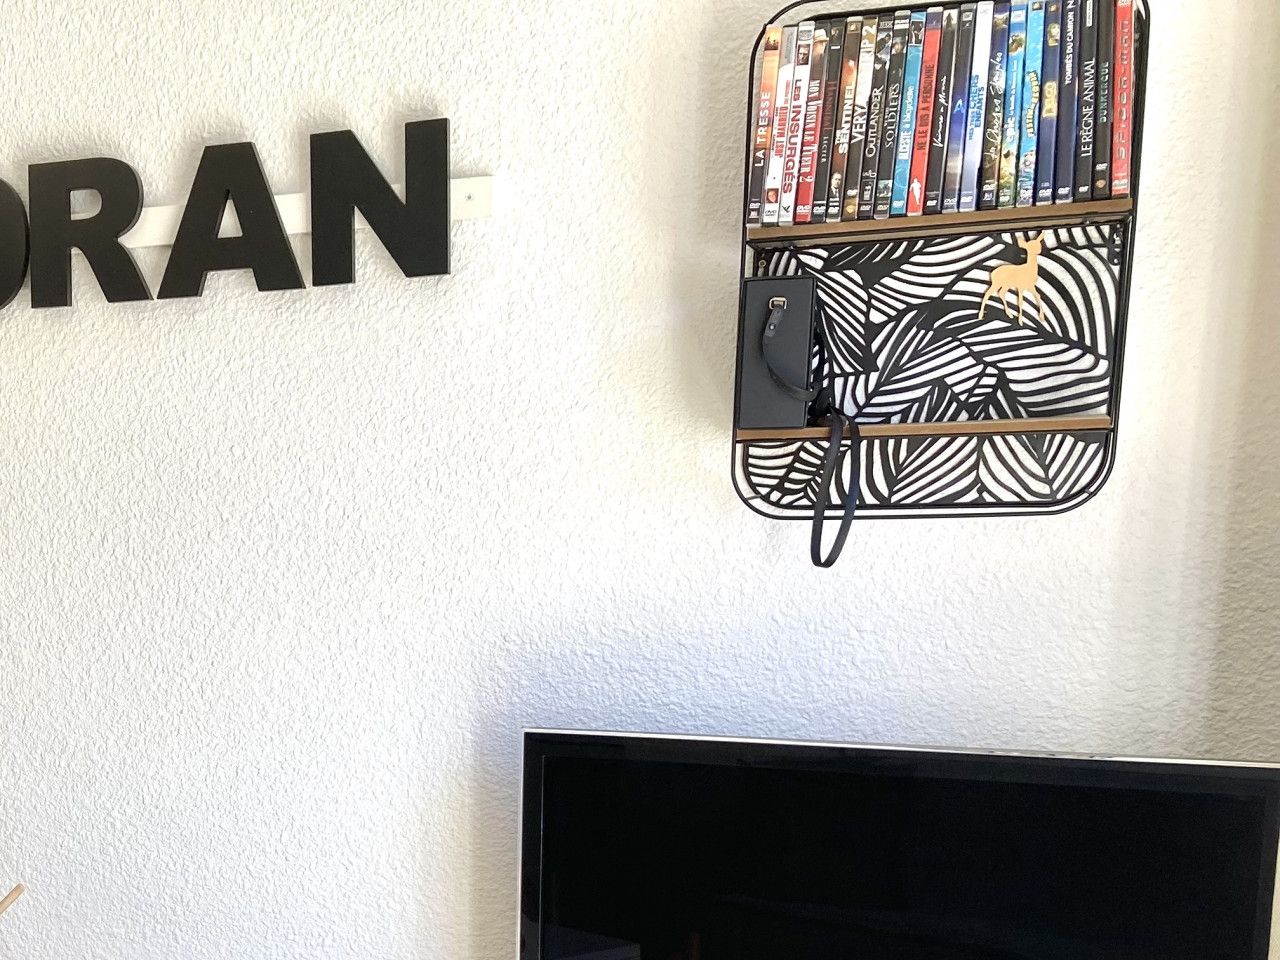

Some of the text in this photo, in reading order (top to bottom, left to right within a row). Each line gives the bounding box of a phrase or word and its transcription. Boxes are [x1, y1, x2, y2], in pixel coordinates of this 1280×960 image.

[1067, 42, 1073, 53] DU
[793, 79, 801, 100] LES
[808, 80, 820, 97] MON
[839, 82, 854, 154] SENTINEL
[885, 83, 900, 148] SOLDIERS
[975, 86, 985, 128] ENFANTS
[1080, 57, 1095, 156] LE RÈGNE ANIMAL
[1099, 62, 1109, 123] DUNKERQUE
[754, 92, 770, 166] LA TRESSE
[783, 105, 801, 193] INSURGÉS
[851, 105, 867, 143] VERY
[865, 86, 884, 157] OUTLANDER
